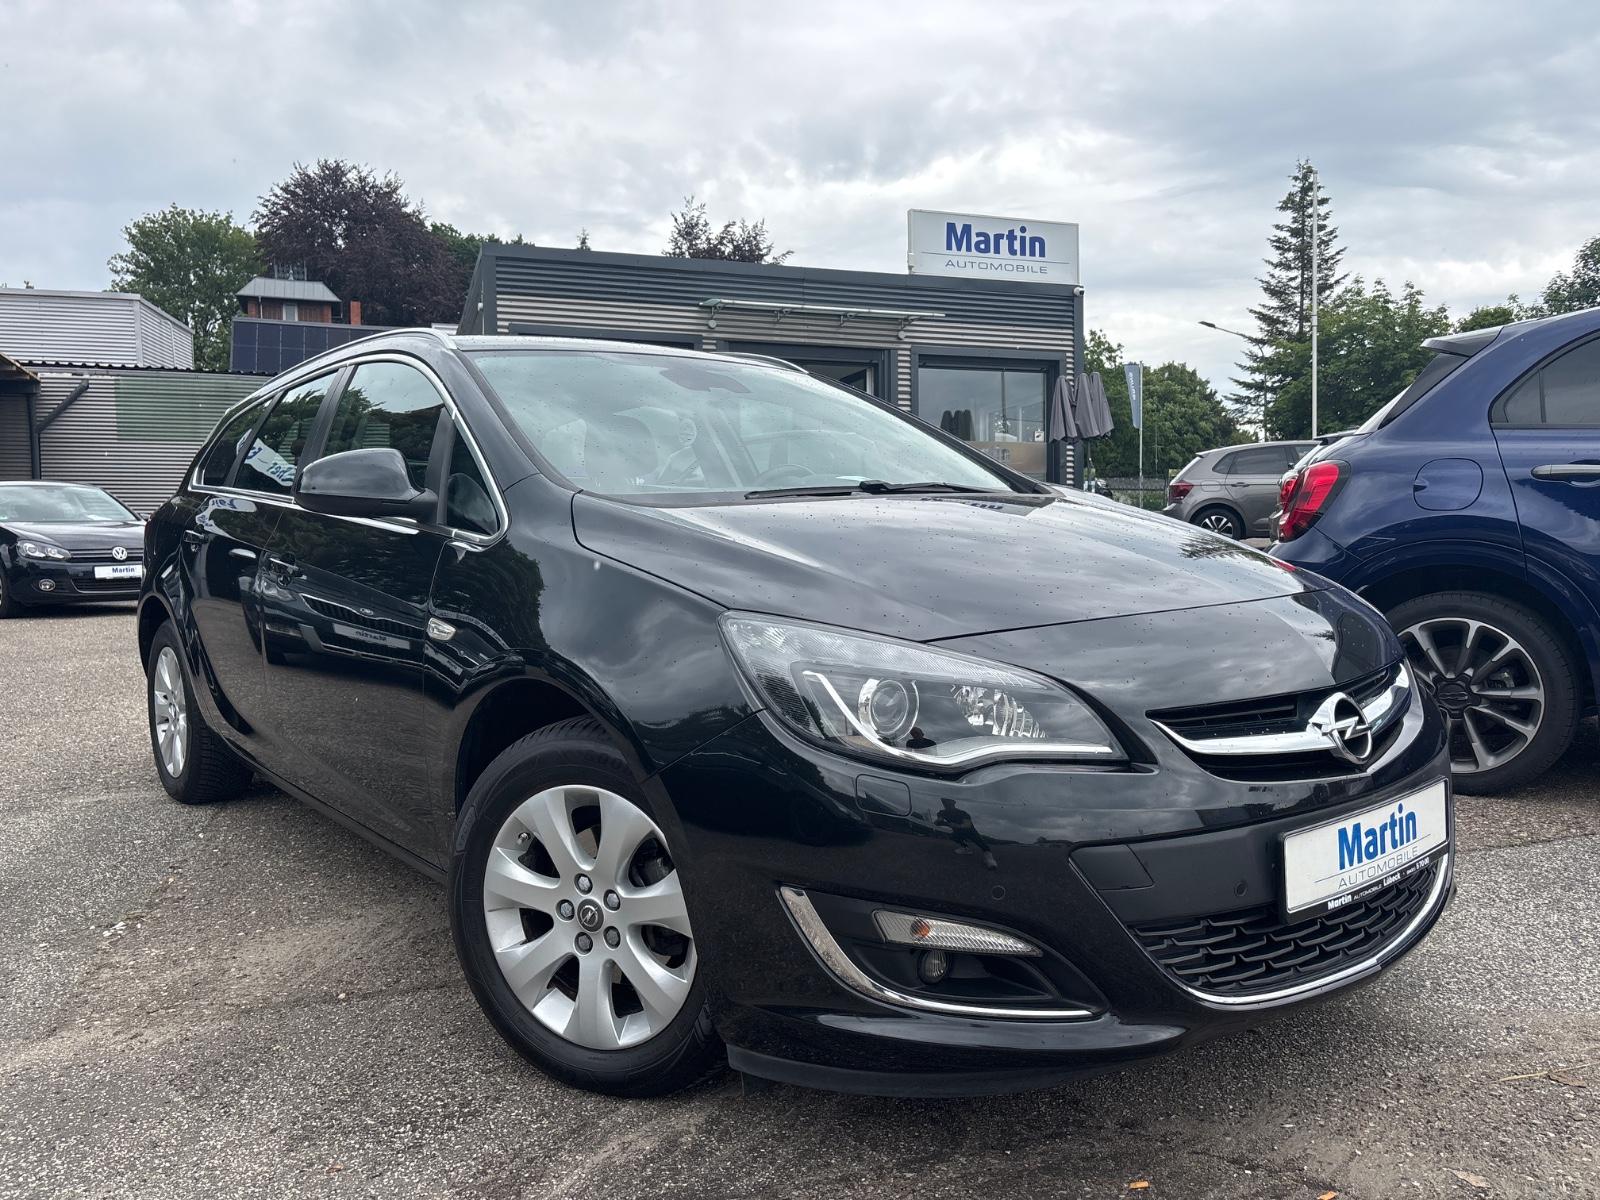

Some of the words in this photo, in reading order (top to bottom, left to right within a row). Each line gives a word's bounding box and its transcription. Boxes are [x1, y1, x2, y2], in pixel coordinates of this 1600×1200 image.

[946, 222, 1046, 258] Martin
[945, 259, 1048, 274] AUTOMOBILE
[1337, 803, 1417, 871] Martin
[1337, 846, 1419, 890] AUTOMOBILE
[1327, 894, 1352, 910] Martin
[1353, 884, 1382, 901] AUTOMOBILE
